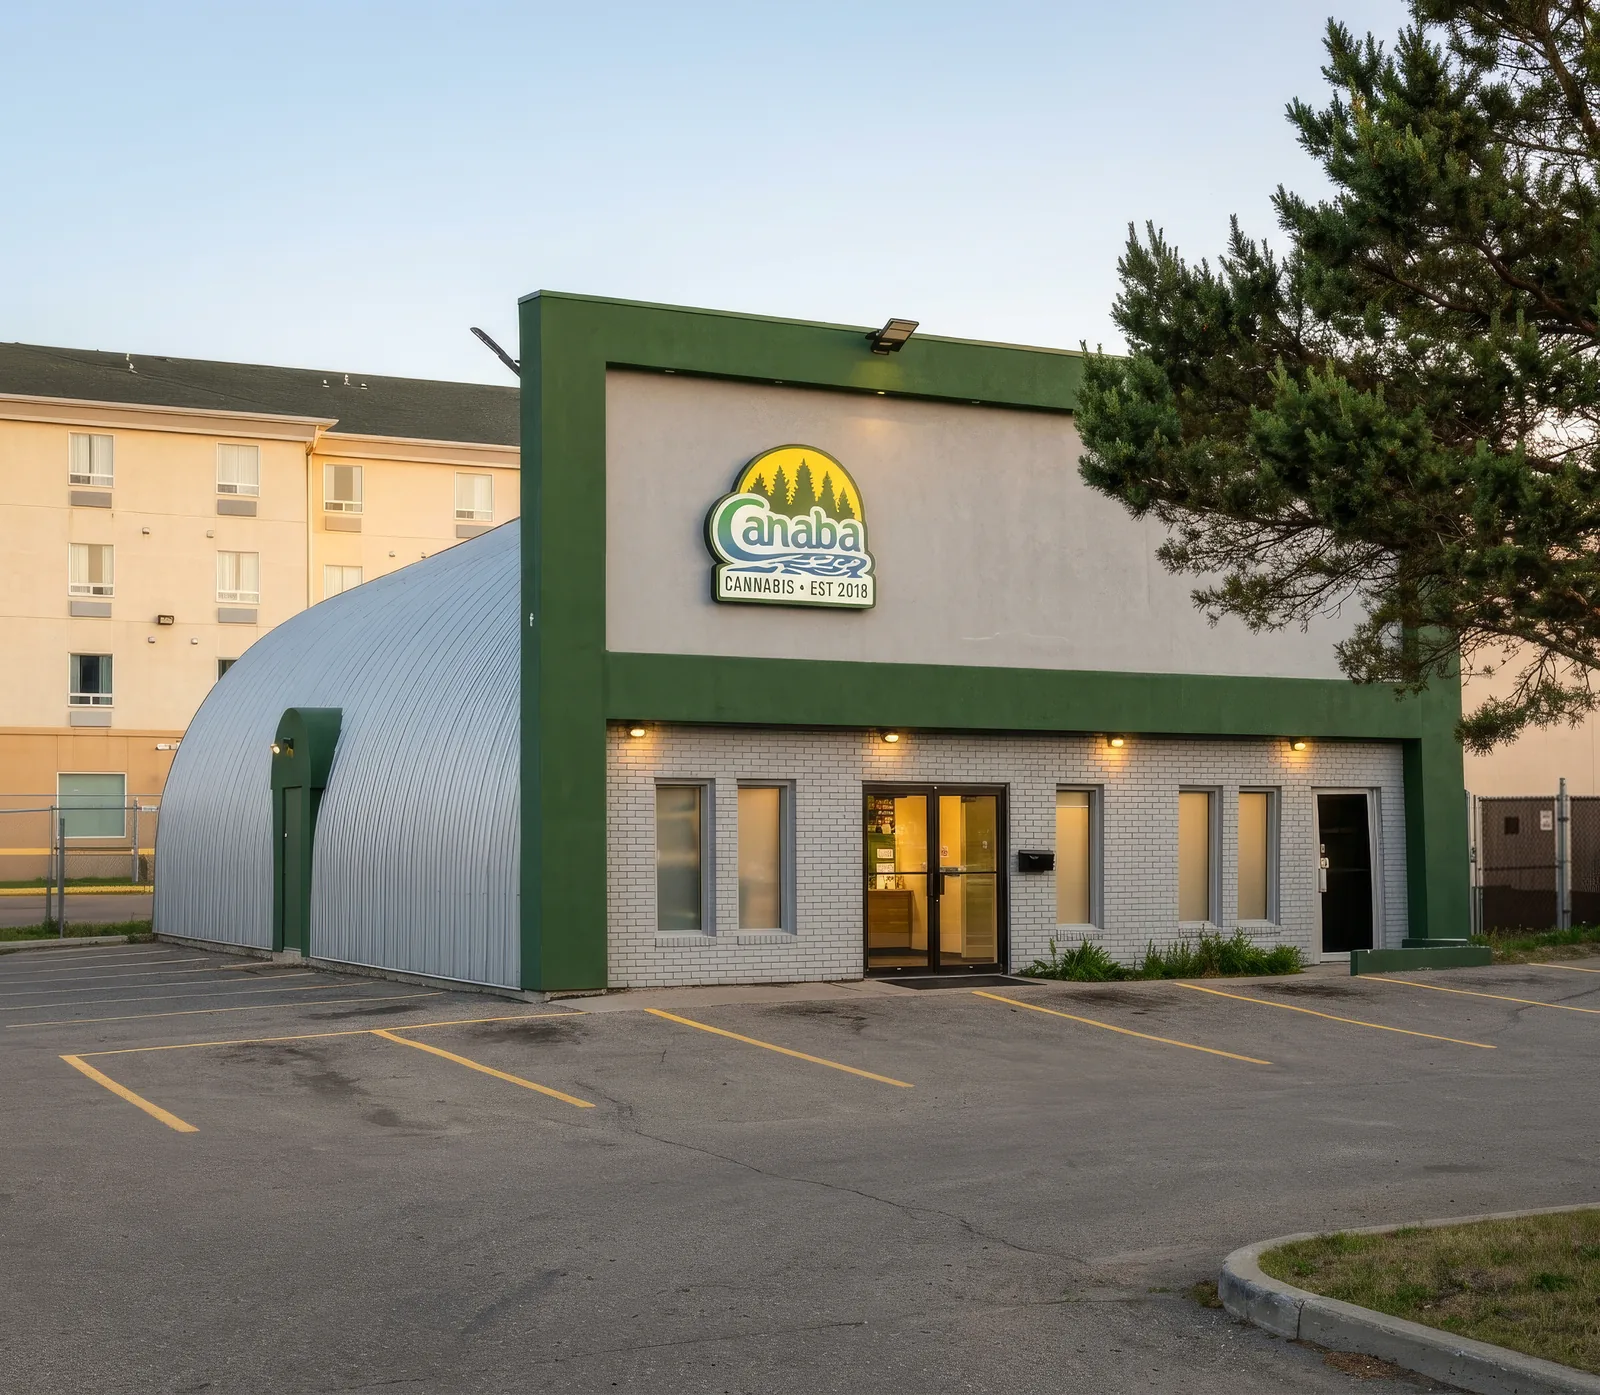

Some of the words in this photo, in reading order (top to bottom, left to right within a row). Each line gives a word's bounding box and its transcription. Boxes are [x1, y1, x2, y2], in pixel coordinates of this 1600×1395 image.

[718, 498, 861, 561] Canaba
[725, 575, 795, 594] CANNABIS
[810, 580, 834, 597] EST
[837, 582, 868, 598] 2018
